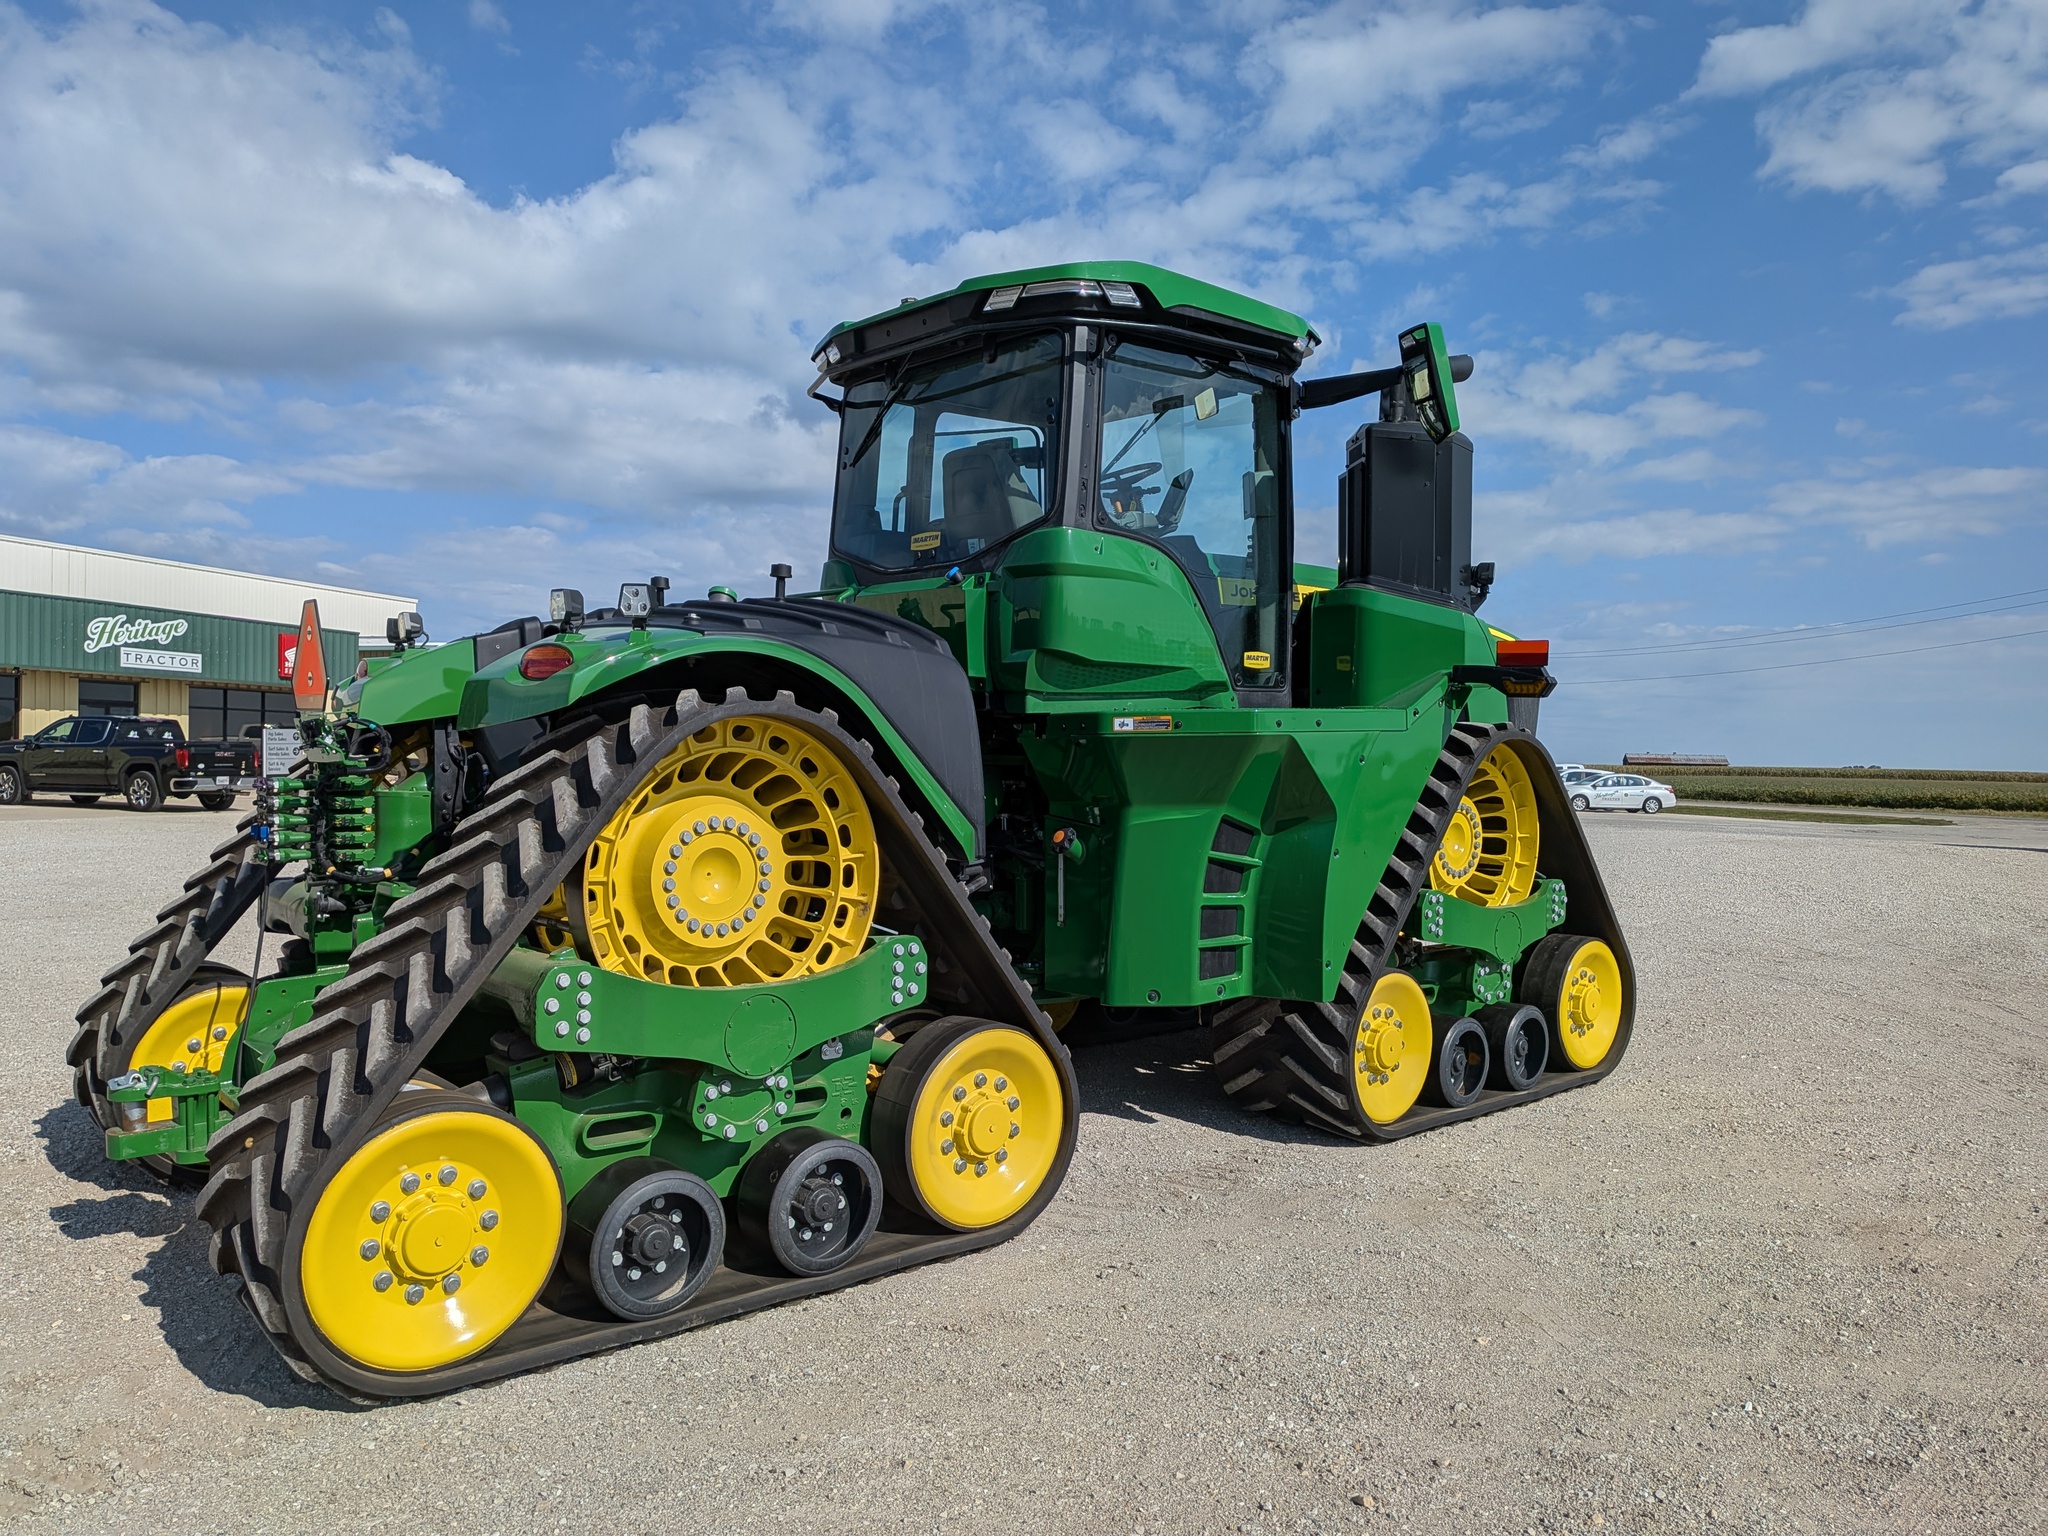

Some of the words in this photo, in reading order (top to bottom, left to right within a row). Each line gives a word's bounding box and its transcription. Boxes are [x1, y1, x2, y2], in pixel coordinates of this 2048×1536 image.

[912, 534, 940, 543] MARTIN
[85, 615, 187, 652] Heritage
[123, 652, 199, 668] TRACTOR
[1246, 654, 1269, 662] MARTIN
